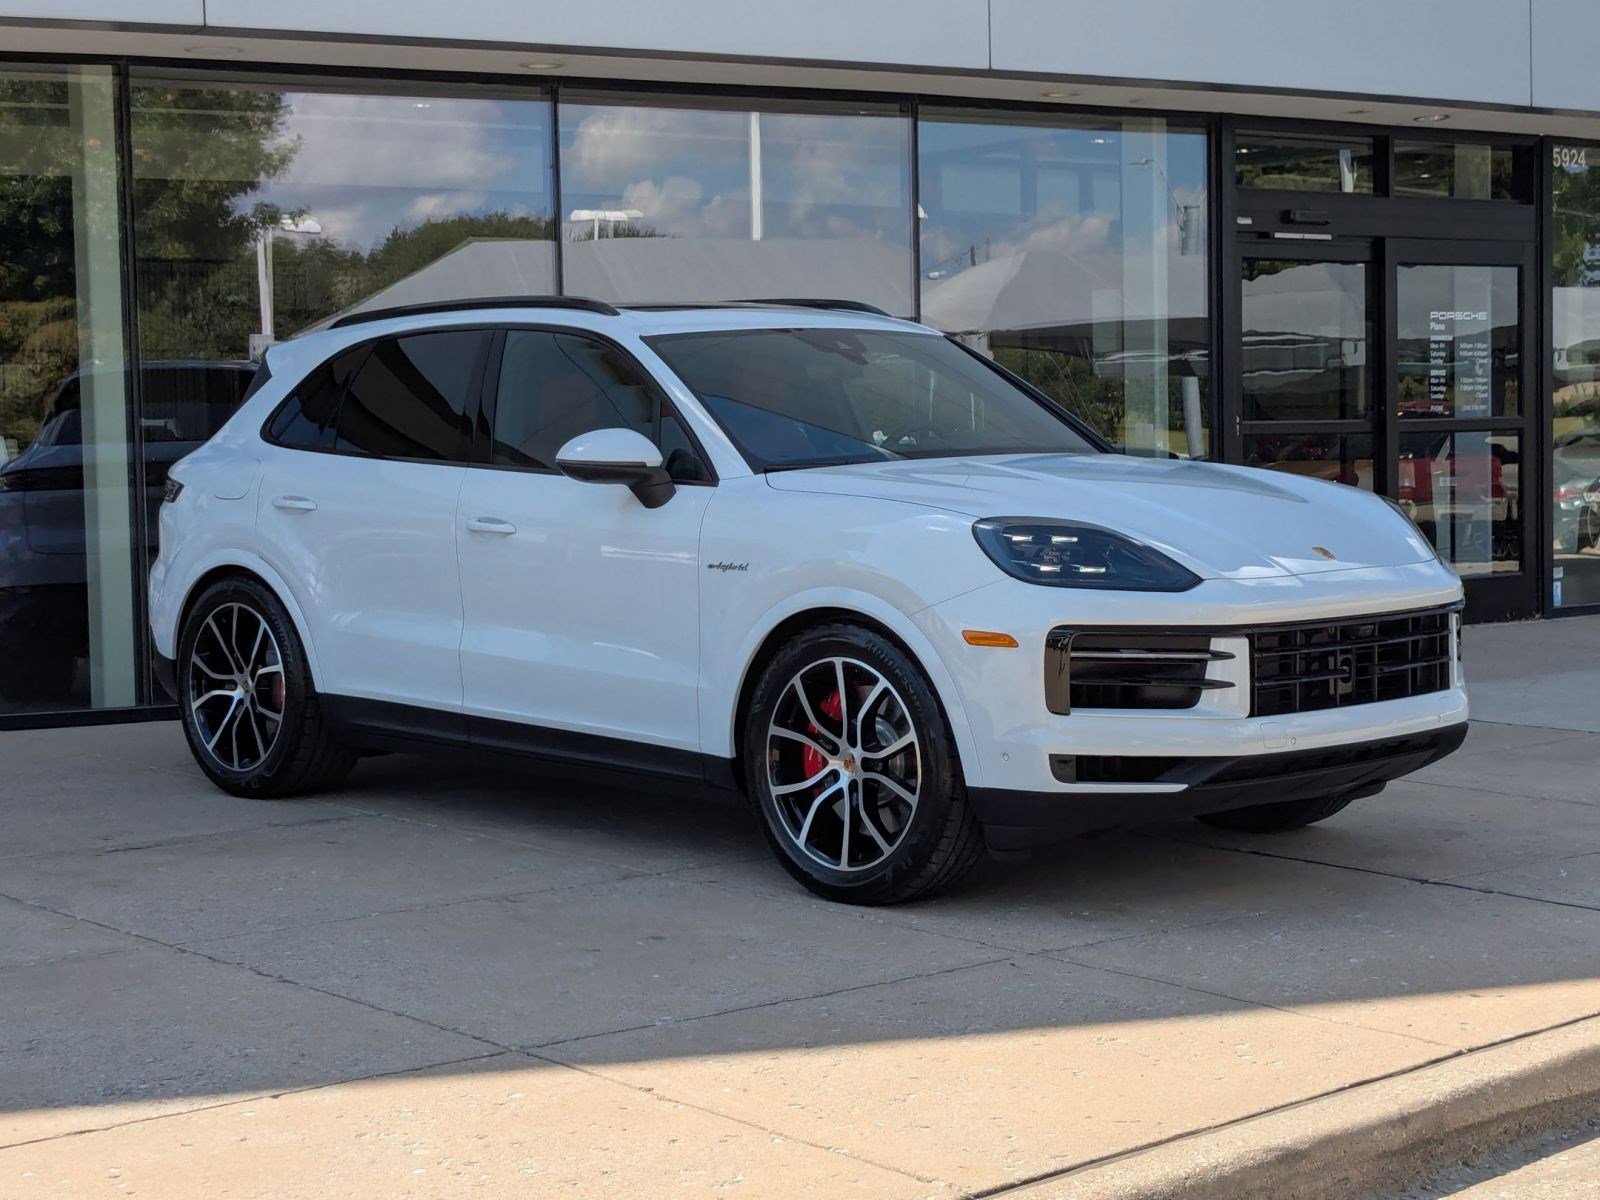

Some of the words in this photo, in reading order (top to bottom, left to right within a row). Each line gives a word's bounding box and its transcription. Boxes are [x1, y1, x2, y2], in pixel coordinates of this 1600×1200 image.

[1553, 148, 1586, 168] 5924
[1430, 311, 1487, 320] PORSCHE
[1430, 322, 1446, 331] Plano
